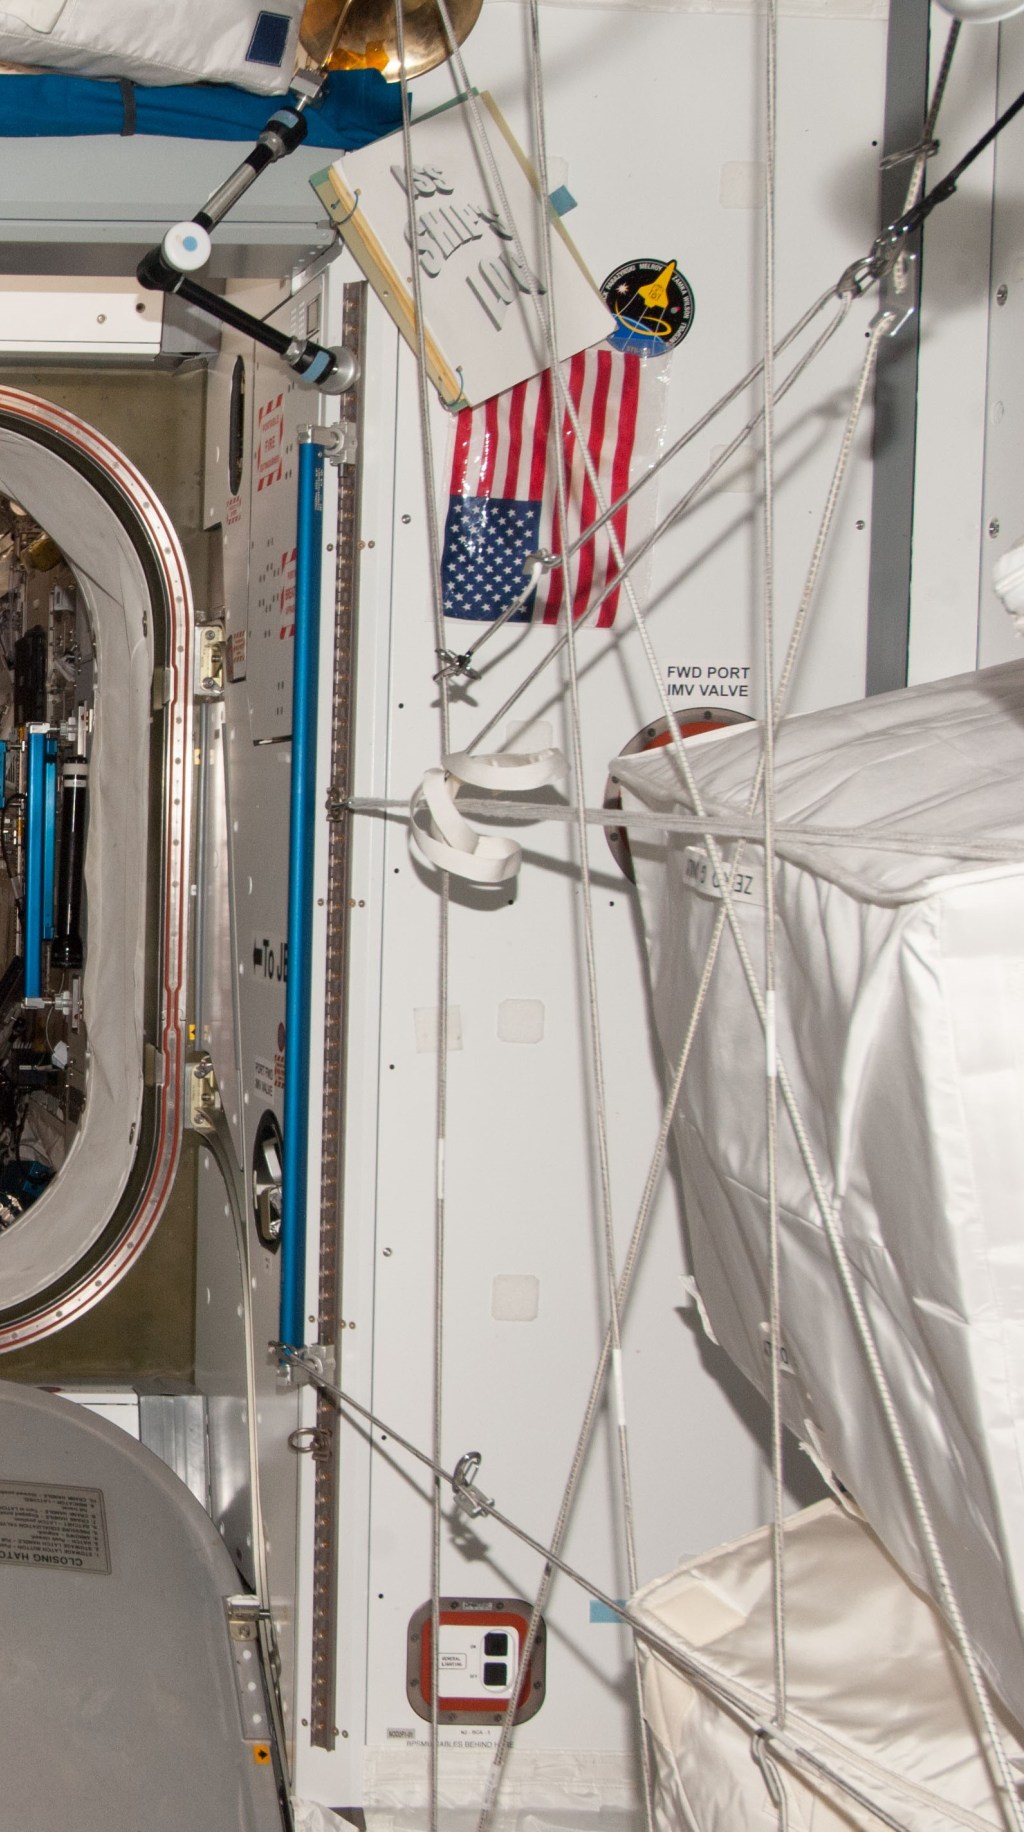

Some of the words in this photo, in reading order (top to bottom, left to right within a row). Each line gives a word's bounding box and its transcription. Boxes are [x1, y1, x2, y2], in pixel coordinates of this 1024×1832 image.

[682, 296, 690, 319] WILSON
[265, 436, 276, 452] FIRE
[667, 666, 702, 679] FWD
[707, 667, 751, 679] PORT
[667, 684, 695, 696] IMV
[699, 684, 749, 697] VALVE
[262, 938, 275, 980] To
[33, 1554, 83, 1566] CLOSING
